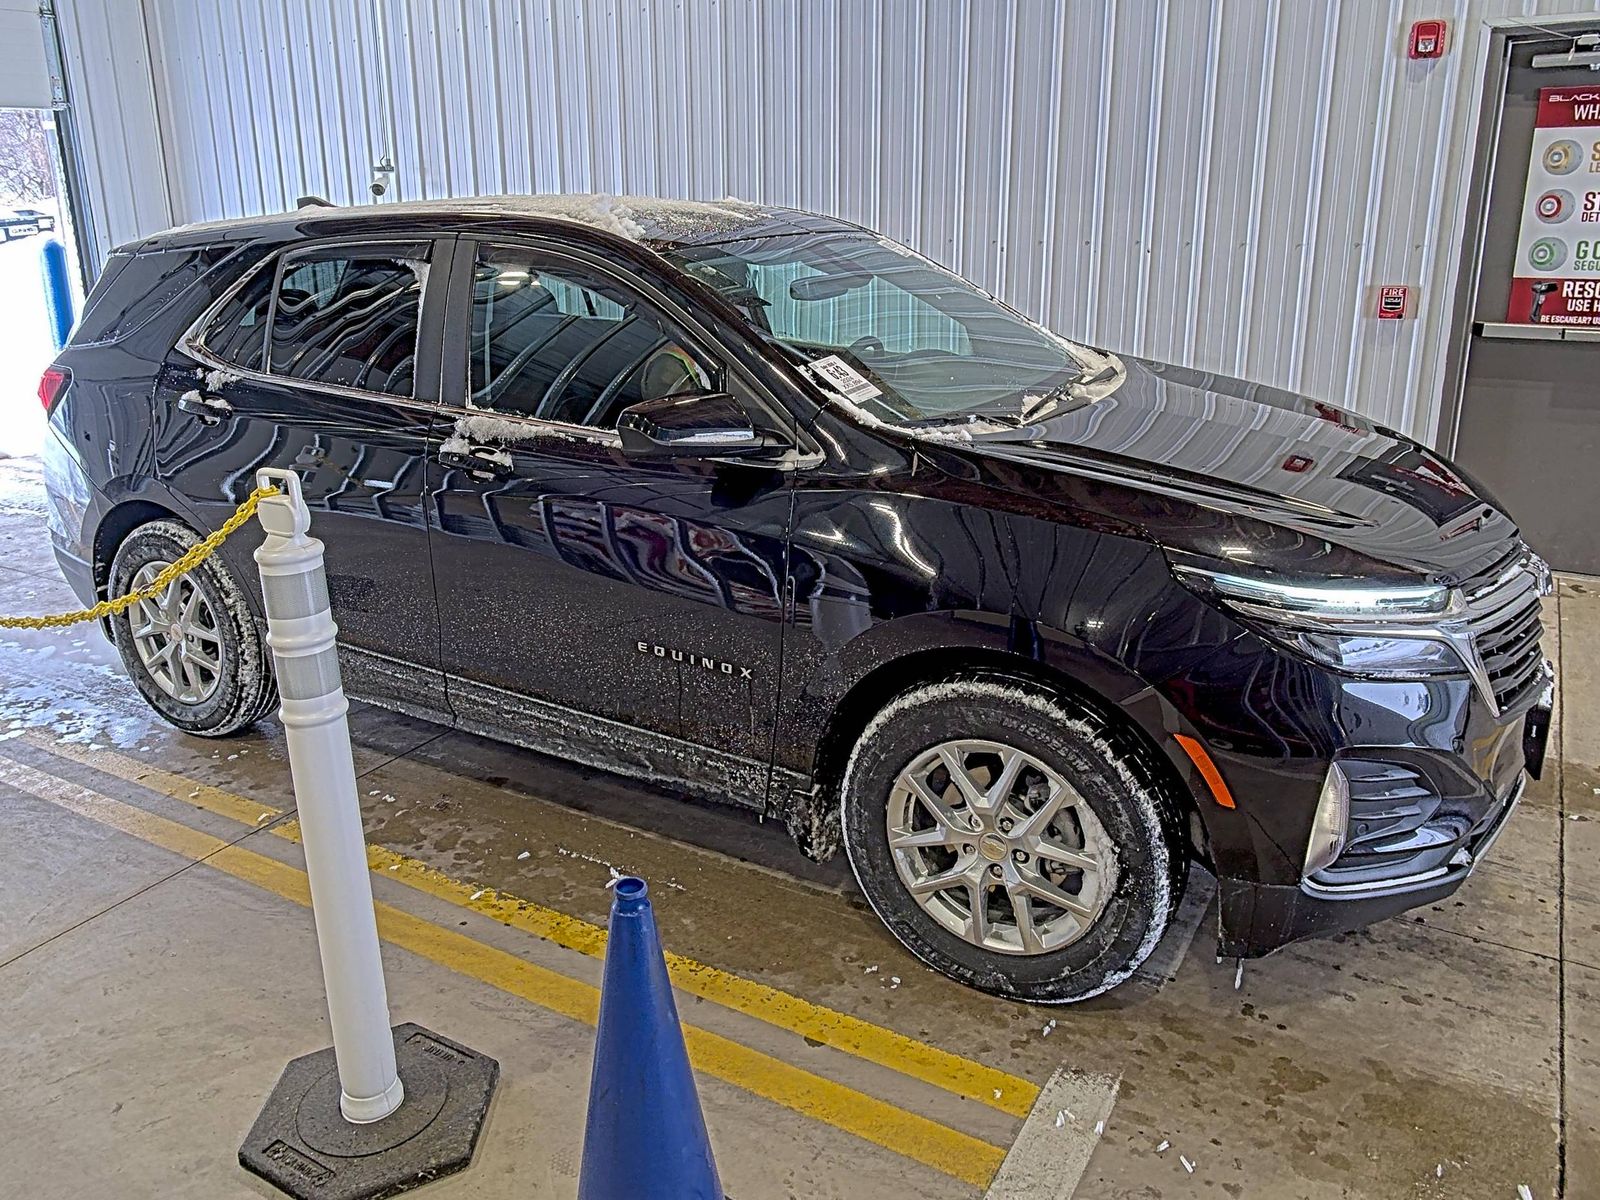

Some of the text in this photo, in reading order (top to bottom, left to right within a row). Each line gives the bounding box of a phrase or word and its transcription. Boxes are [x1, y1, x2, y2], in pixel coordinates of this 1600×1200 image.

[1574, 104, 1600, 120] WH
[1583, 191, 1600, 211] S
[1383, 288, 1405, 296] FIRE
[1567, 298, 1591, 312] USE
[1540, 315, 1551, 323] RE
[637, 641, 752, 680] EQUINOX
